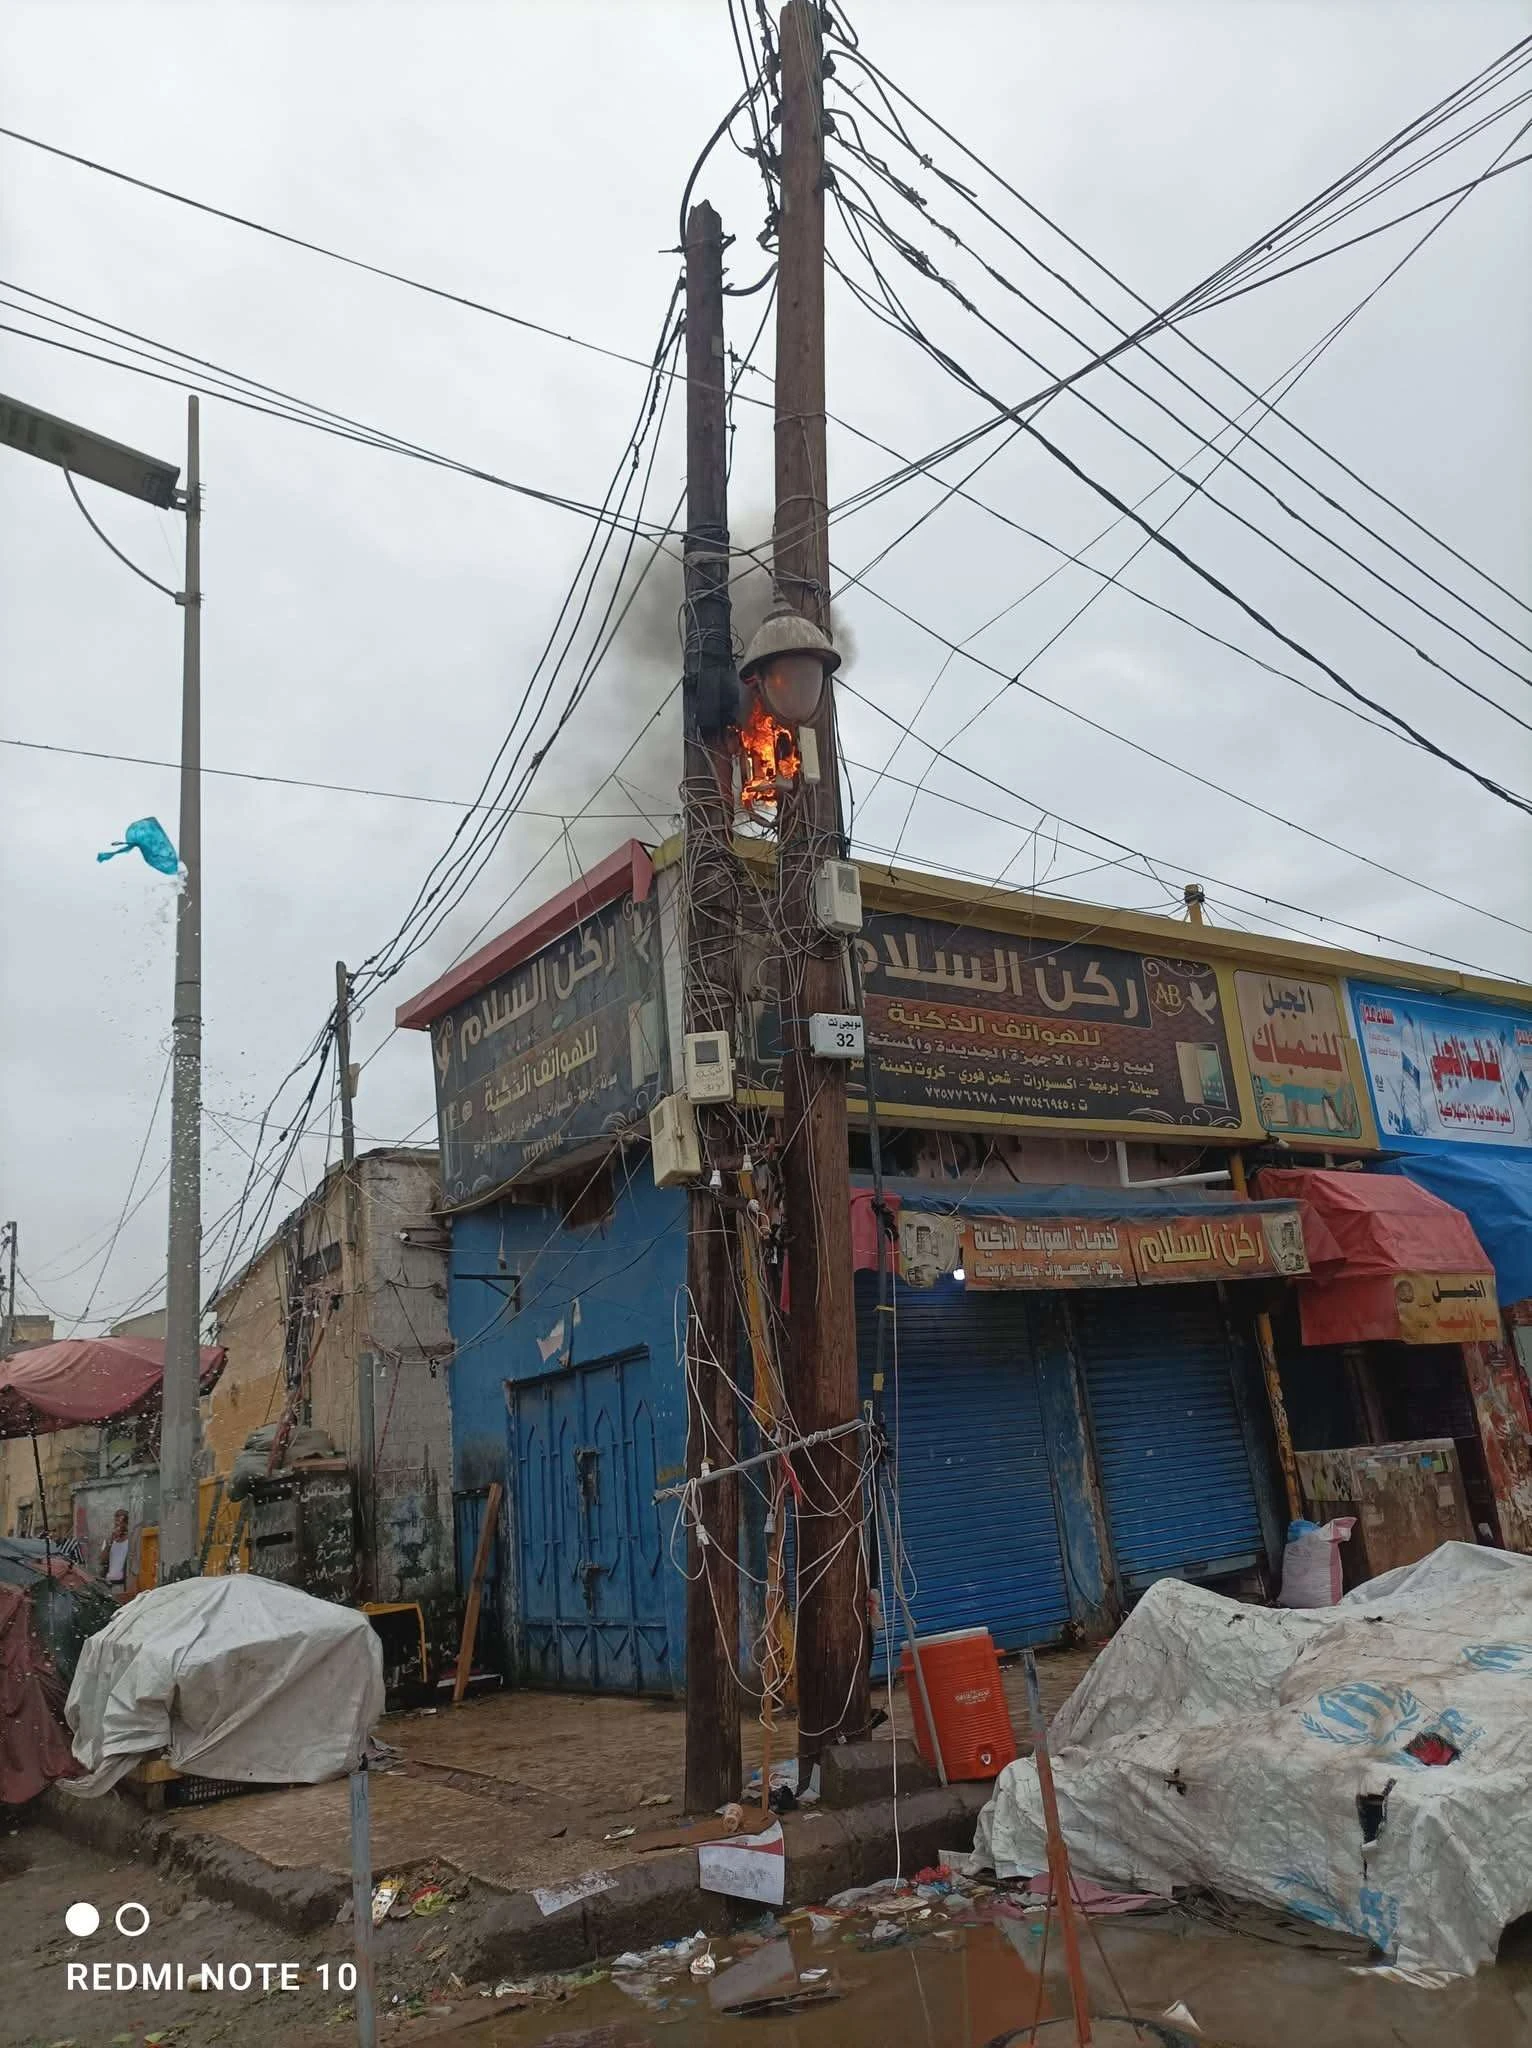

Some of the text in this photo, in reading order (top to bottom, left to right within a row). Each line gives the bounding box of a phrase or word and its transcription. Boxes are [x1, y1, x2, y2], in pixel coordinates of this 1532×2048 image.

[460, 924, 616, 1063] ركن السلام
[1034, 956, 1138, 1019] ركن
[1263, 979, 1314, 1018] الجبل
[887, 1002, 1101, 1047] للهواتف الذكية
[836, 1032, 855, 1048] 32
[935, 1039, 1007, 1061] الجديدة
[533, 1025, 598, 1090] للهواتف
[1075, 1055, 1120, 1073] وشراء
[1122, 1061, 1154, 1076] لبيع
[914, 1061, 946, 1080] كروت
[958, 1067, 985, 1085] فوري
[987, 1069, 1011, 1085] شحن
[484, 1064, 532, 1113] الذكية
[1088, 1078, 1119, 1096] برمجة
[1128, 1080, 1160, 1097] صيانة
[972, 1223, 1019, 1258] الذكية
[1022, 1223, 1073, 1258] الهواتف
[1139, 1222, 1265, 1273] ركن السلام
[1432, 1279, 1487, 1303] الجبل
